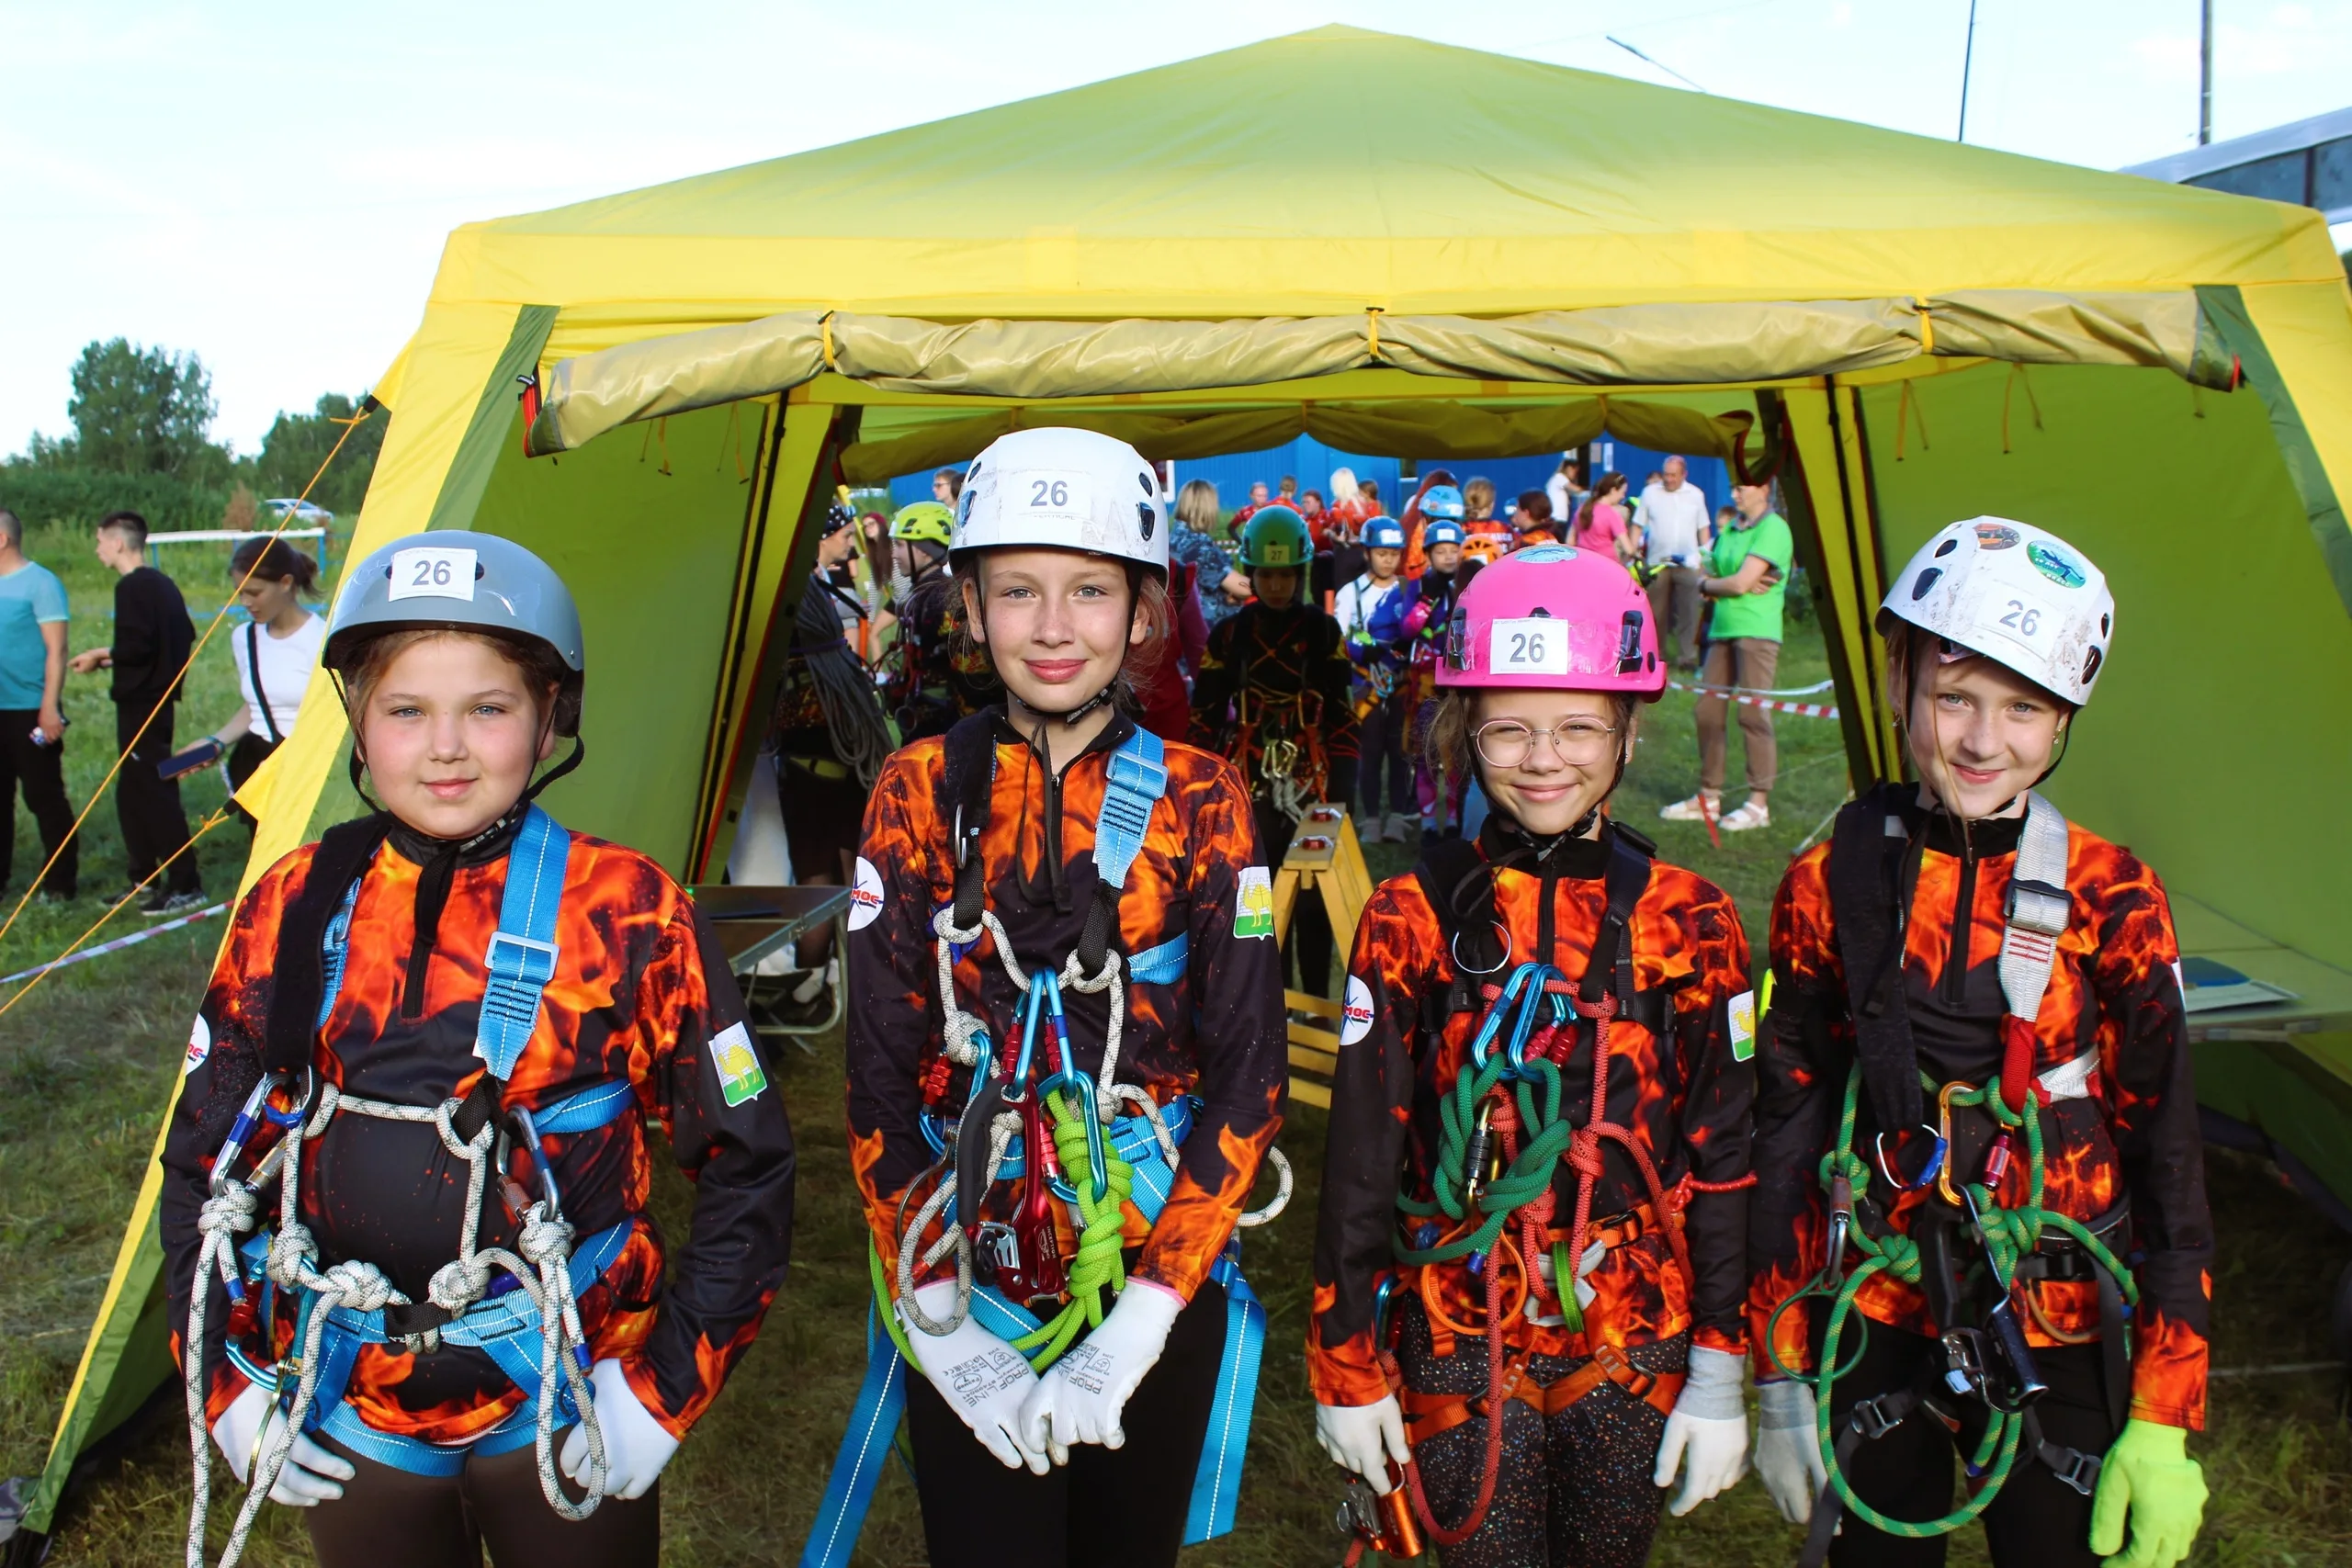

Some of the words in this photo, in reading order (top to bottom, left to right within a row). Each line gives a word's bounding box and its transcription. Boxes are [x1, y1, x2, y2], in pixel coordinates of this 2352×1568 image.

[1030, 480, 1068, 506] 26
[412, 560, 451, 586] 26
[1999, 600, 2041, 636] 26
[1510, 634, 1545, 663] 26
[996, 1364, 1030, 1390] PROF
[1068, 1373, 1102, 1394] PROF
[965, 1384, 998, 1407] LINE
